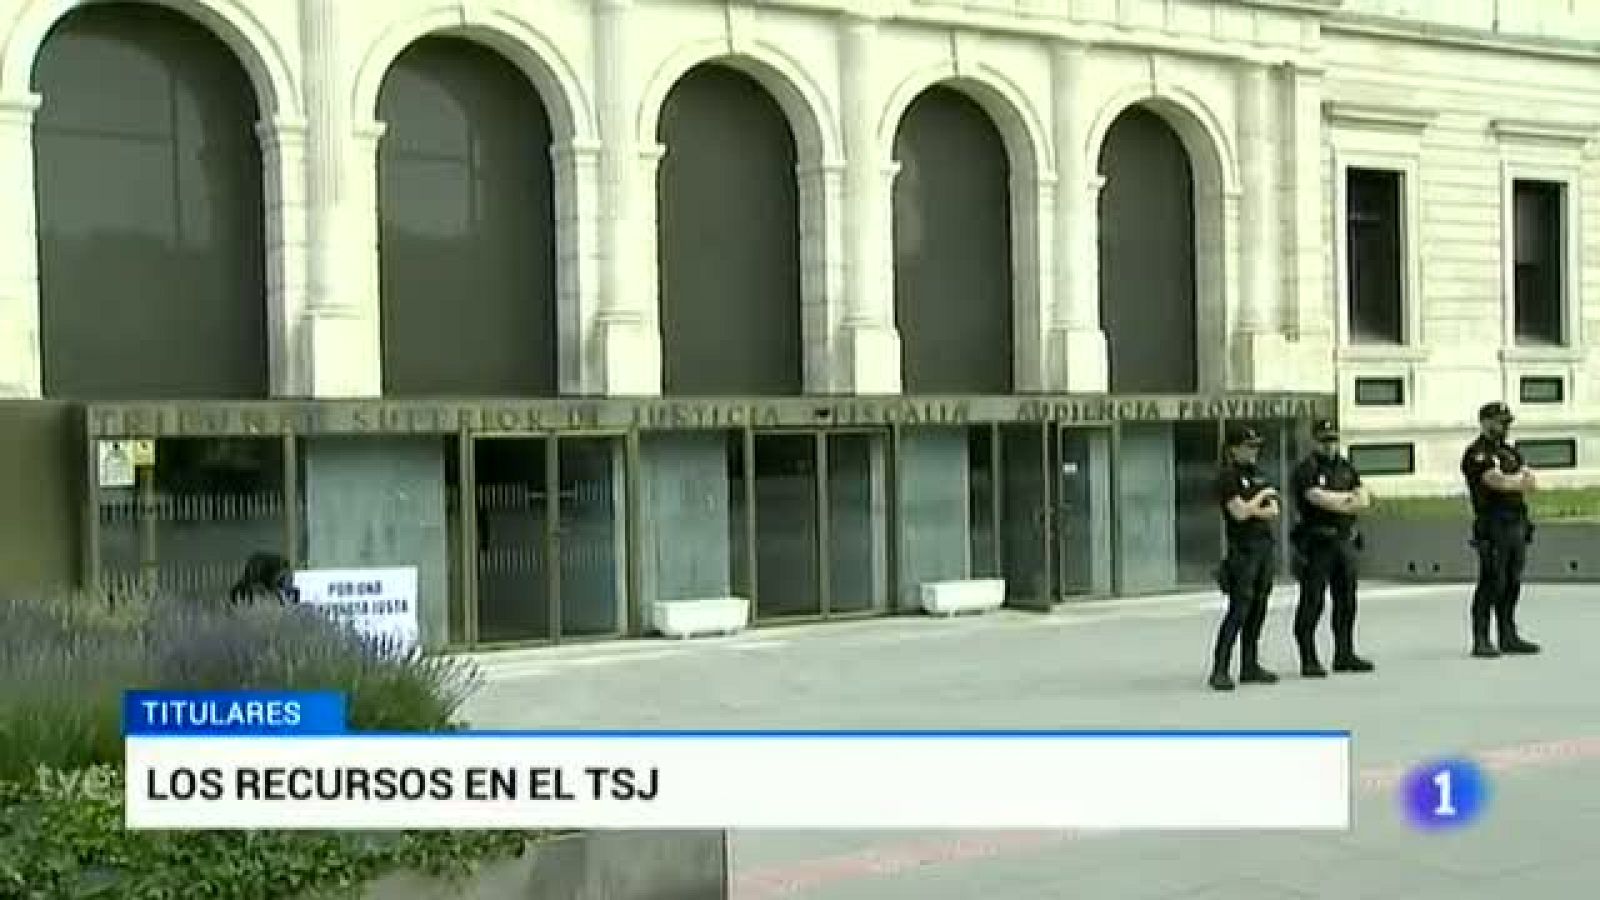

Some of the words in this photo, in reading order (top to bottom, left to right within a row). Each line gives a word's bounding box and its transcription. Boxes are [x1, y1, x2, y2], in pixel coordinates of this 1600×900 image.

[632, 403, 780, 427] JUSTICIA
[1017, 399, 1161, 420] AUDIENCIA
[1178, 398, 1318, 418] PROVINCIAL
[327, 582, 353, 597] POR
